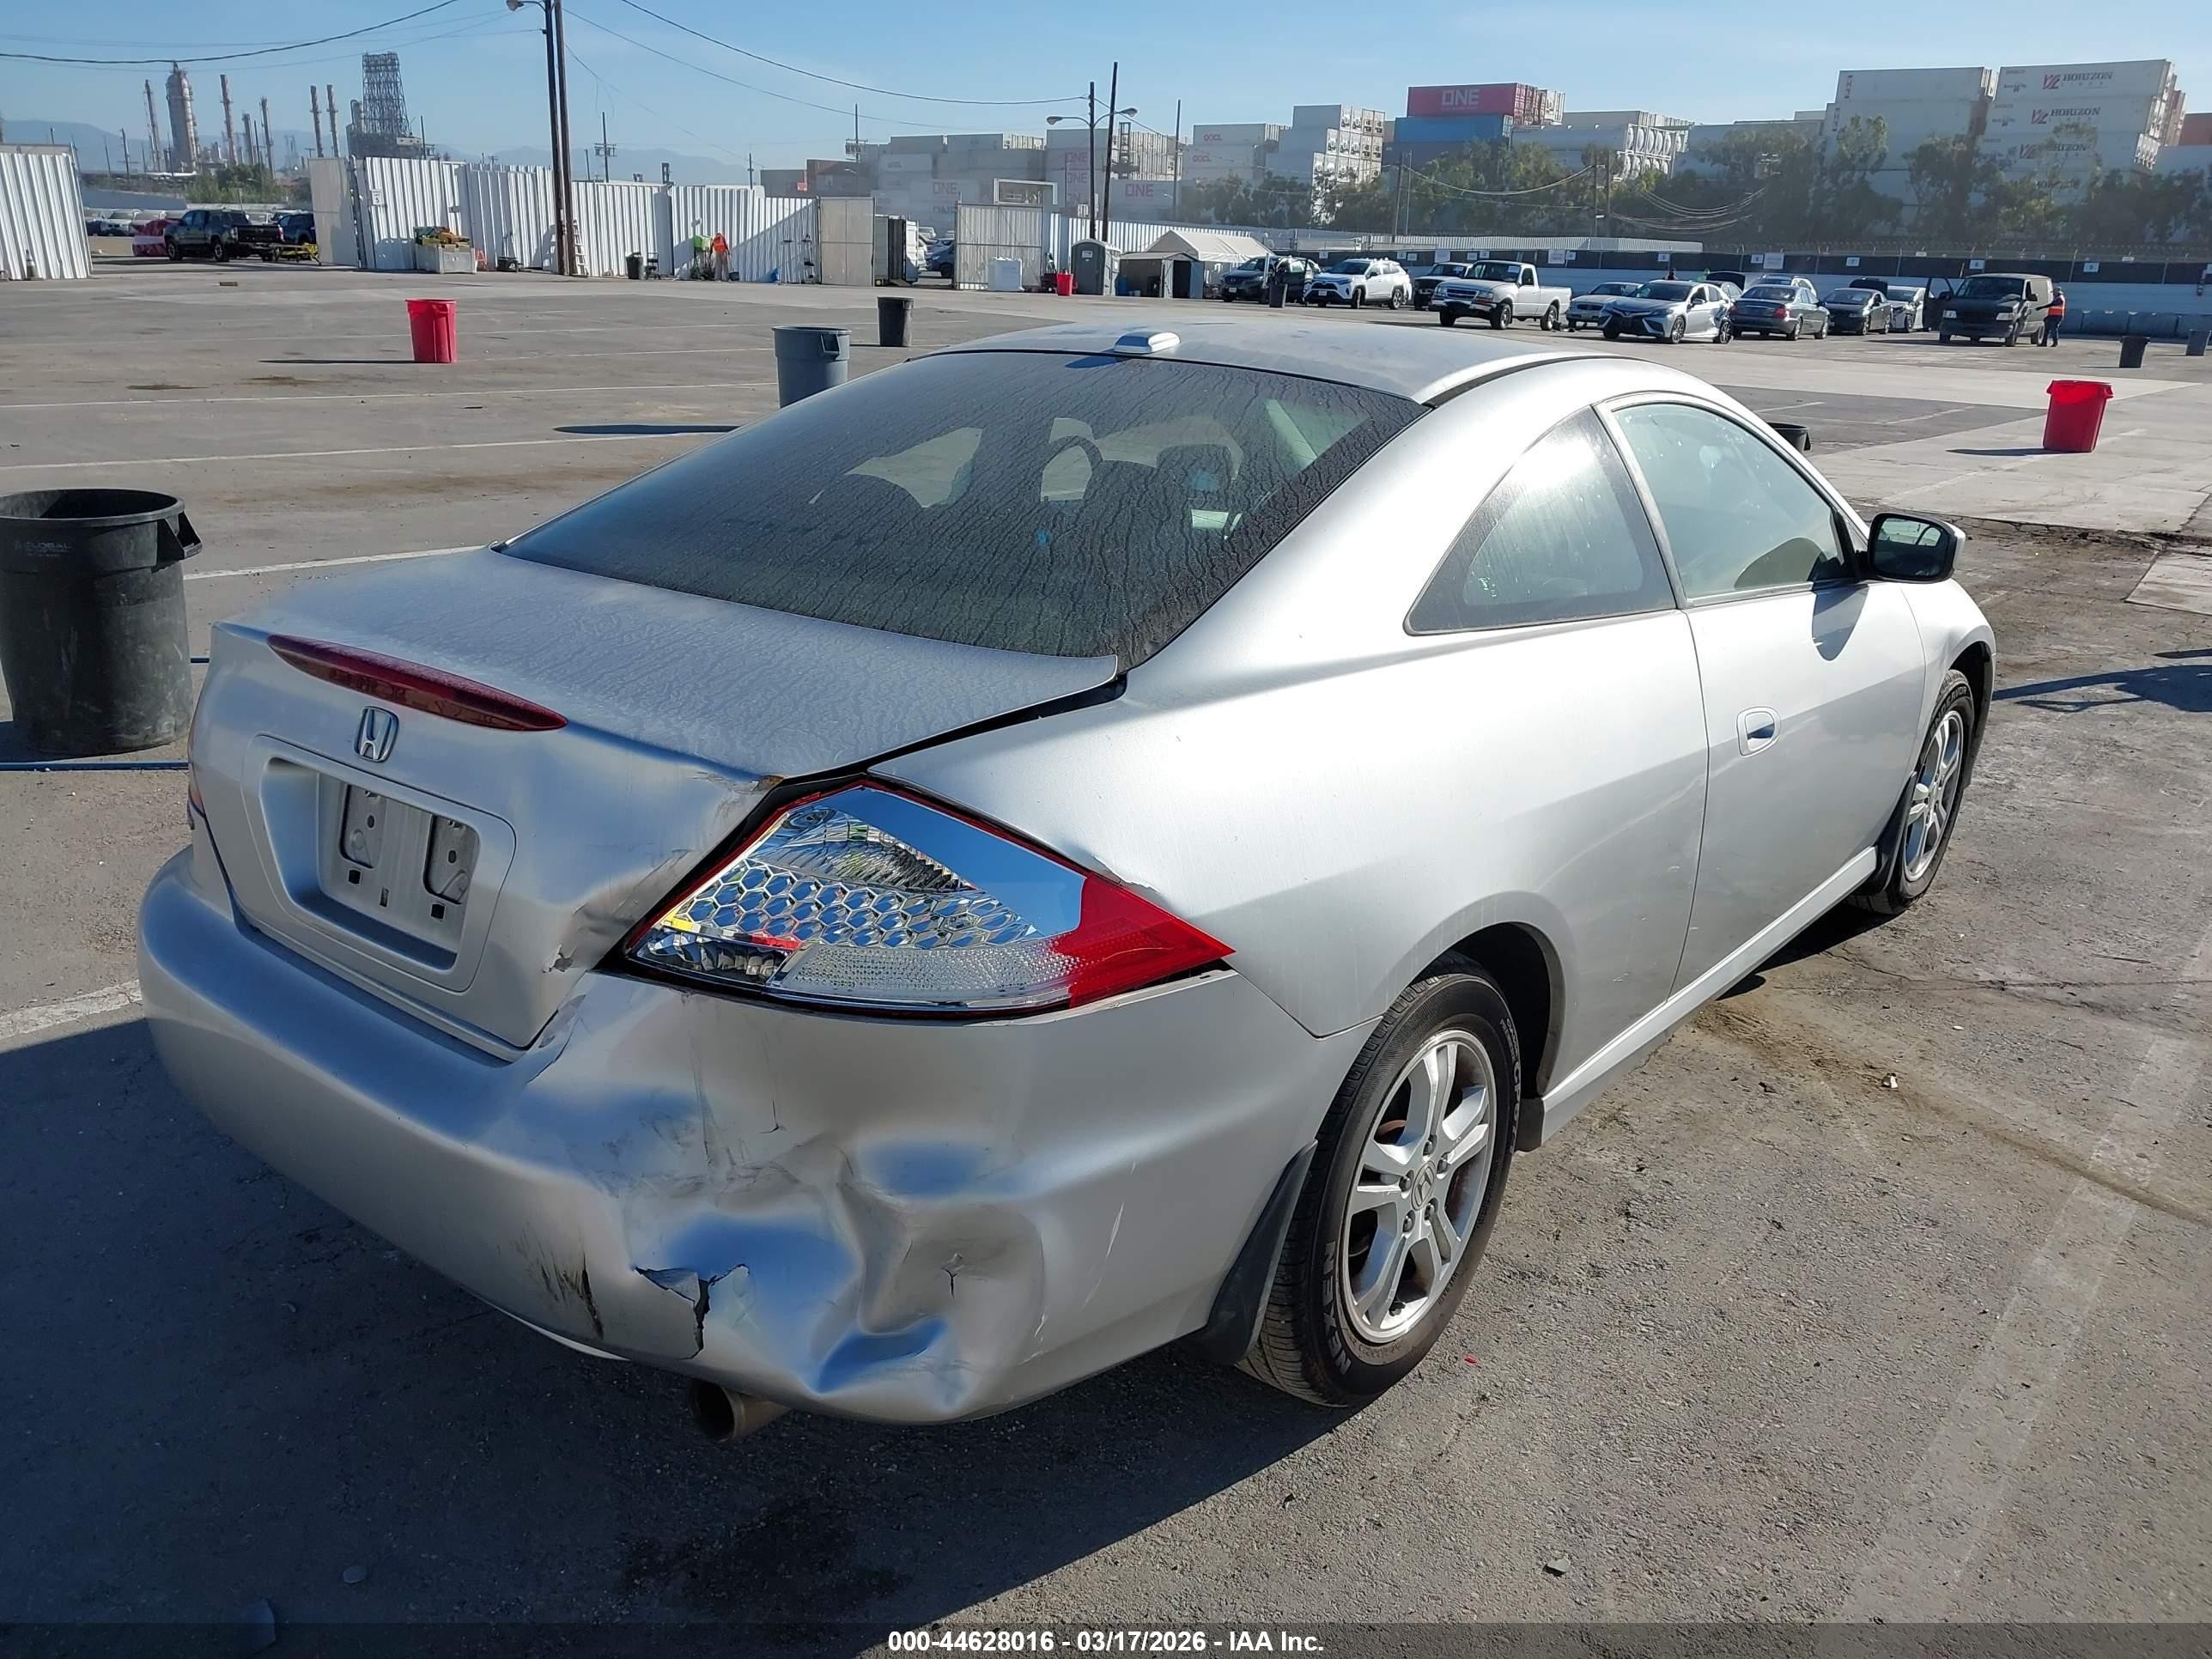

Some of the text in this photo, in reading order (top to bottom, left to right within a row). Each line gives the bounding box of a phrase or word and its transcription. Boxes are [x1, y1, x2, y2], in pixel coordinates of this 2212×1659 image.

[2063, 71, 2113, 82] HORIZON
[1442, 88, 1480, 106] ONE
[2050, 107, 2101, 117] HORIZON
[1065, 151, 1089, 163] ONE
[933, 181, 957, 194] ONE
[1125, 184, 1155, 198] ONE
[1322, 1240, 1352, 1375] NEXEN
